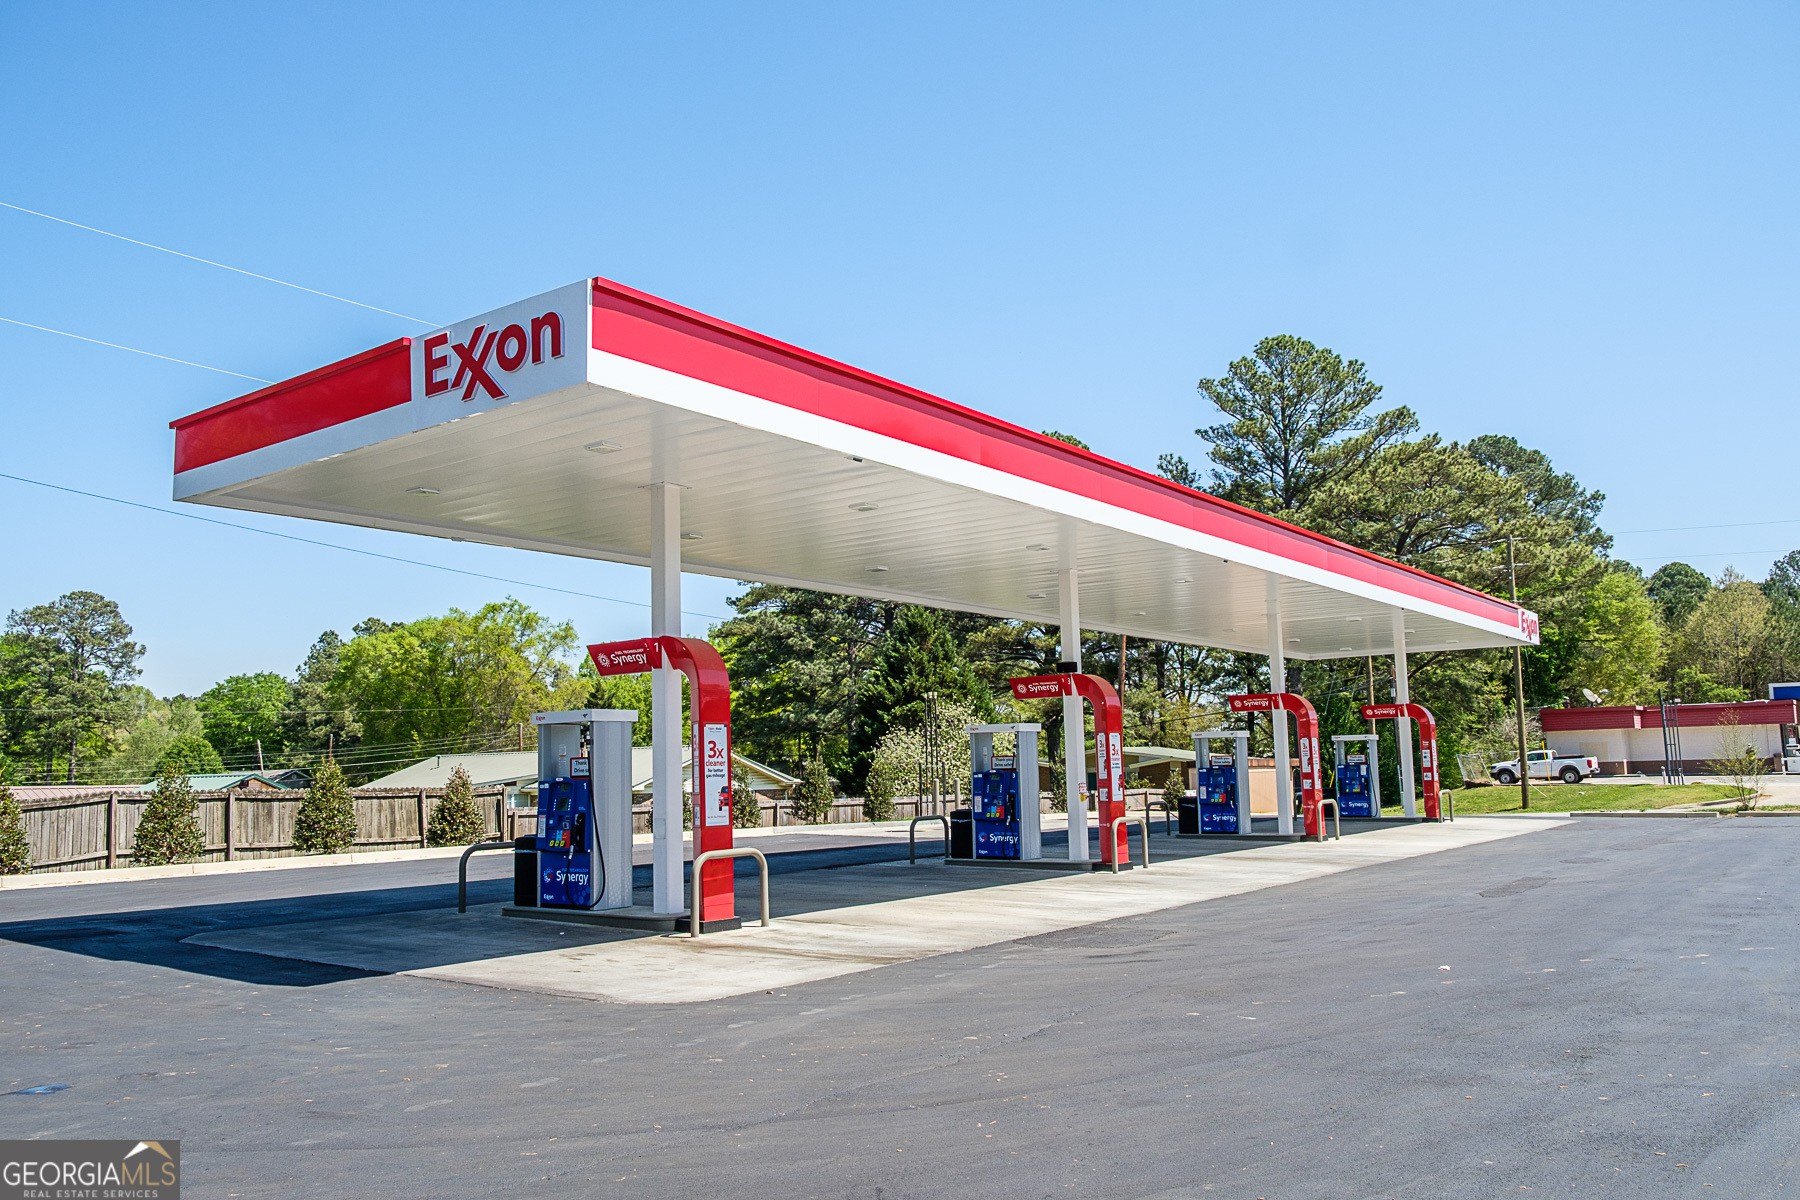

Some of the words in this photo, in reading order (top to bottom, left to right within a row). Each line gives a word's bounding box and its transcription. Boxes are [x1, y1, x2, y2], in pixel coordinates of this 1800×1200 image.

[424, 311, 563, 402] Exxon
[1521, 611, 1537, 641] Exxon
[653, 642, 659, 652] 1
[610, 653, 647, 666] Synergy
[1028, 684, 1059, 693] Synergy
[707, 740, 724, 759] 3x
[1111, 743, 1120, 756] 3x
[706, 759, 726, 767] cleaner
[583, 782, 587, 790] 1
[1212, 814, 1237, 822] Synergy
[989, 833, 1019, 844] Synergy
[556, 870, 589, 886] Synergy
